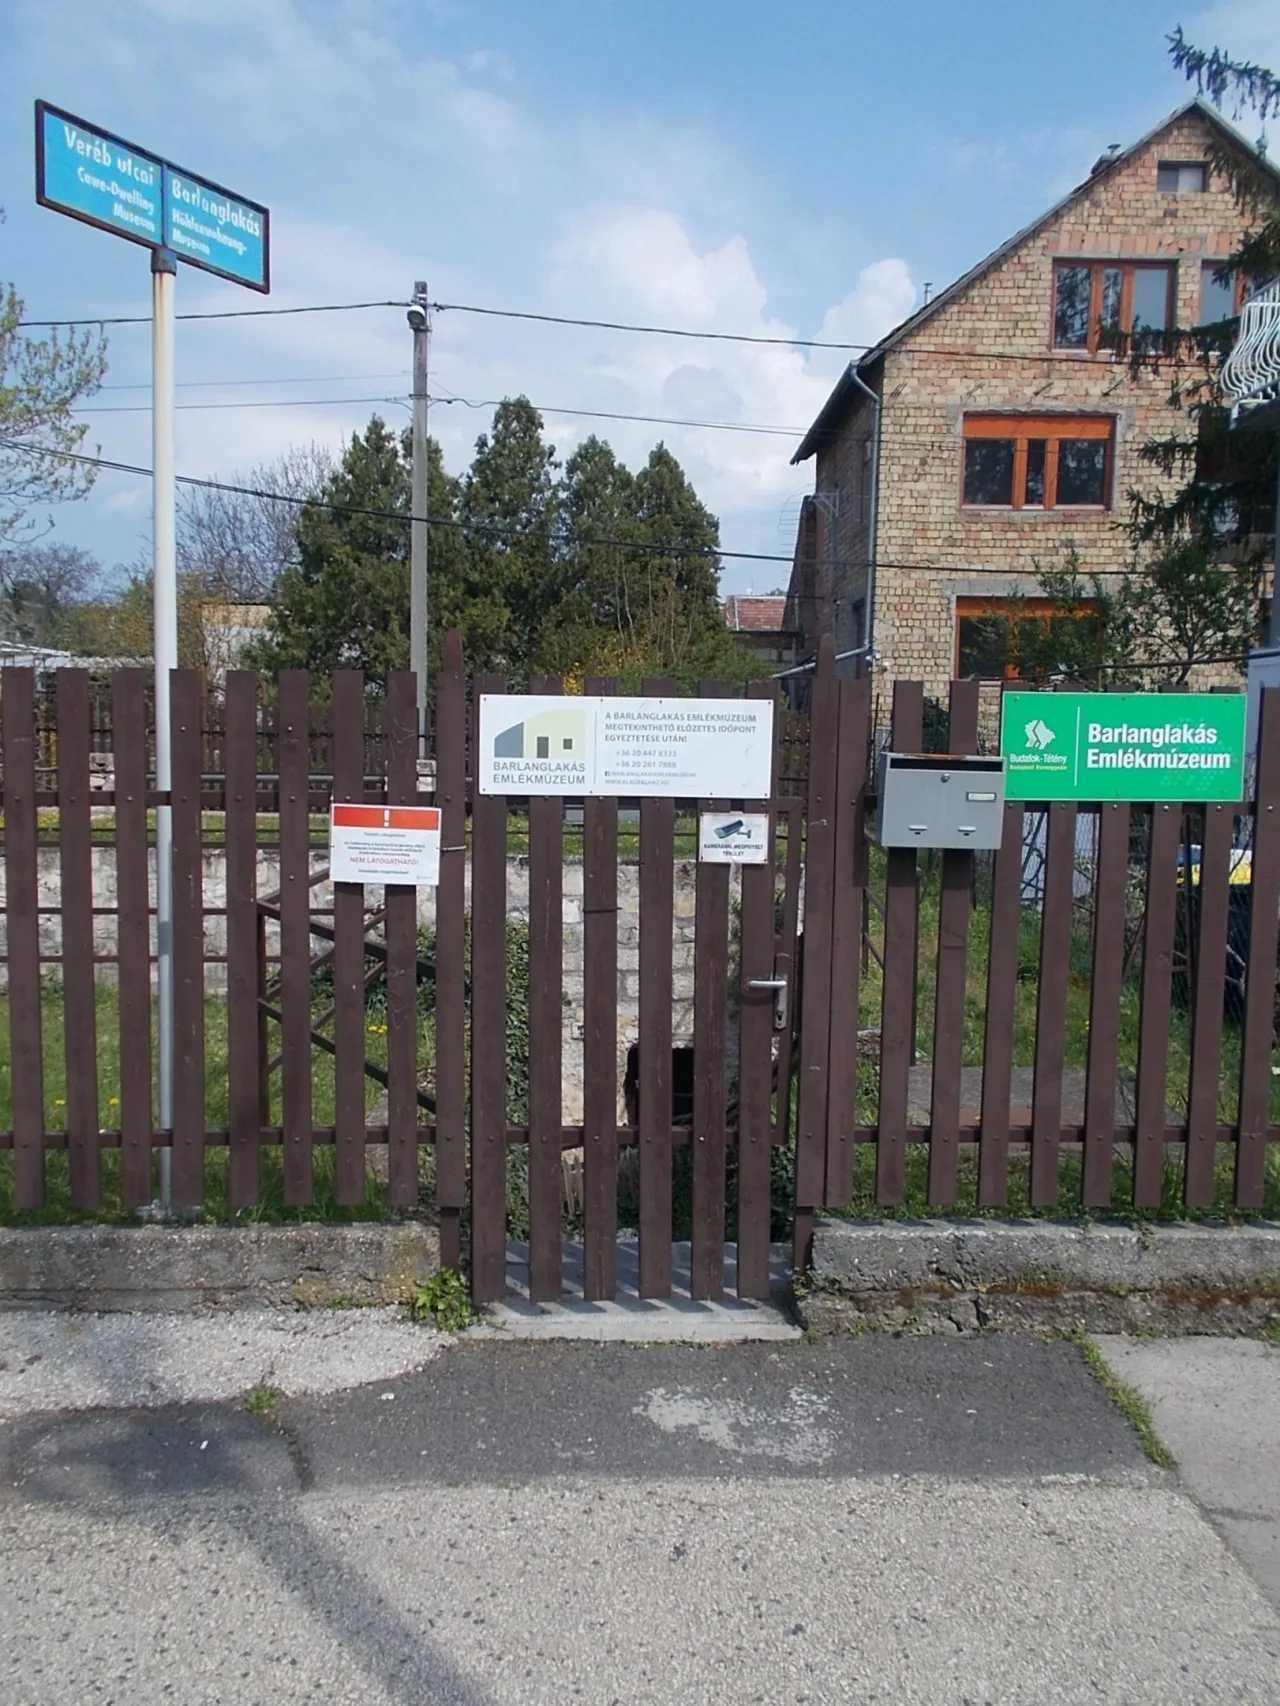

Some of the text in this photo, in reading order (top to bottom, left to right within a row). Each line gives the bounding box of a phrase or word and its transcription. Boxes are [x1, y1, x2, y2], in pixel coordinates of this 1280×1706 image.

[64, 126, 154, 186] Veréb utcai
[113, 202, 155, 232] Museum
[172, 179, 260, 237] Barlanglakás
[172, 228, 210, 255] Museum
[605, 712, 757, 722] A BARLANGLAKÁS EMLÉKMÚZEUM
[605, 723, 756, 733] MEGTEKINTHETŐ ELŐZETES IDŐPONT
[1088, 722, 1218, 748] Barlanglakás
[605, 734, 687, 743] EGYEZTETÉSE UTÁN!
[493, 760, 586, 773] BARLANGLAKÁS
[1087, 746, 1231, 770] Emlékmúzeum
[493, 772, 586, 785] EMLÉKMÚZEUM
[350, 856, 366, 864] NEM
